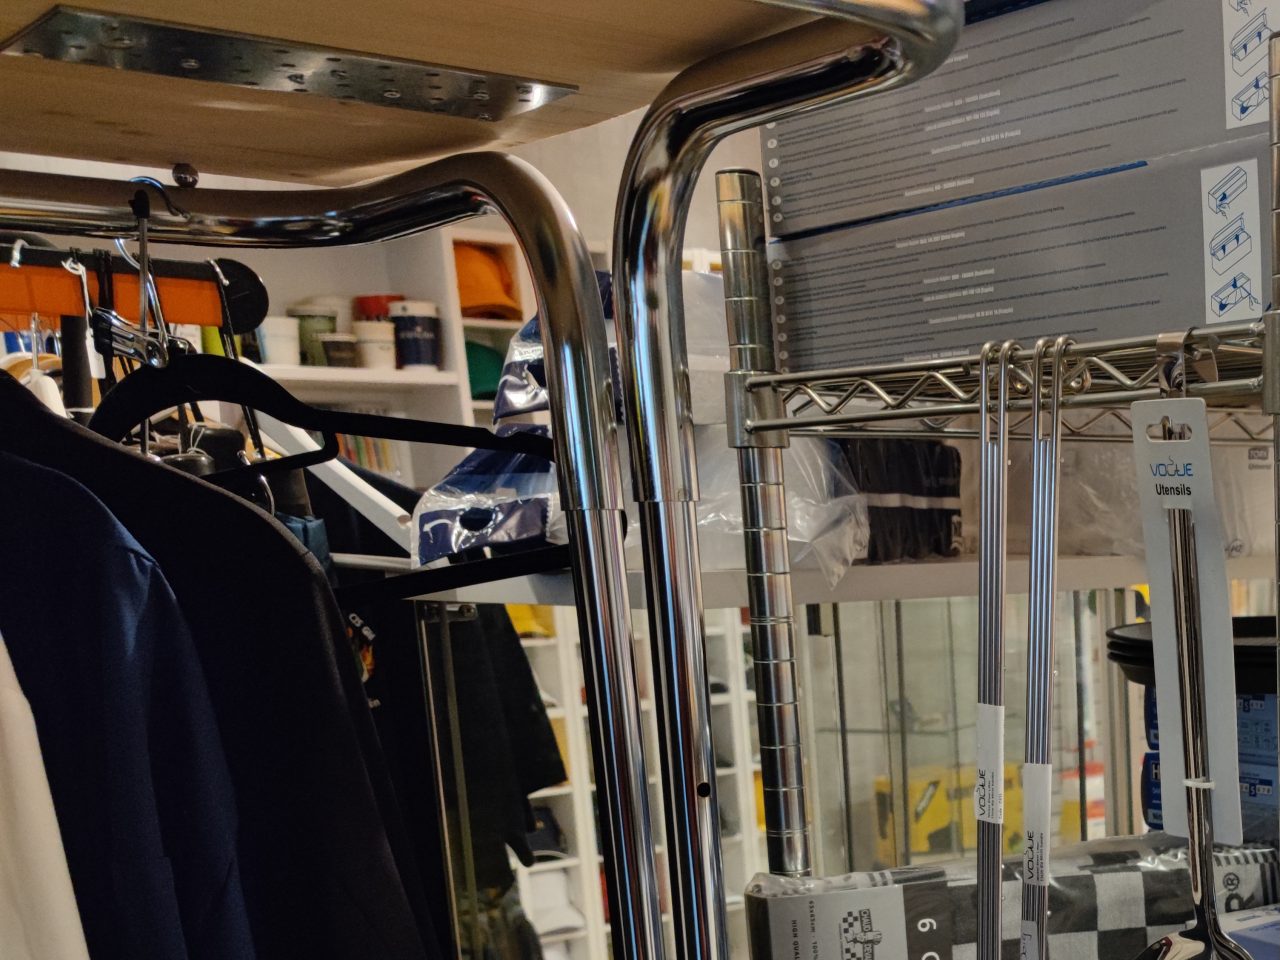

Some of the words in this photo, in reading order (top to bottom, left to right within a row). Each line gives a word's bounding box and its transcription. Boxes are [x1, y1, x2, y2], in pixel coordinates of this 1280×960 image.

[1150, 459, 1194, 477] VOGUE
[1155, 483, 1192, 496] Utensils
[977, 769, 986, 816] VOGUE
[1025, 830, 1034, 880] VOGUE
[917, 918, 937, 932] 6
